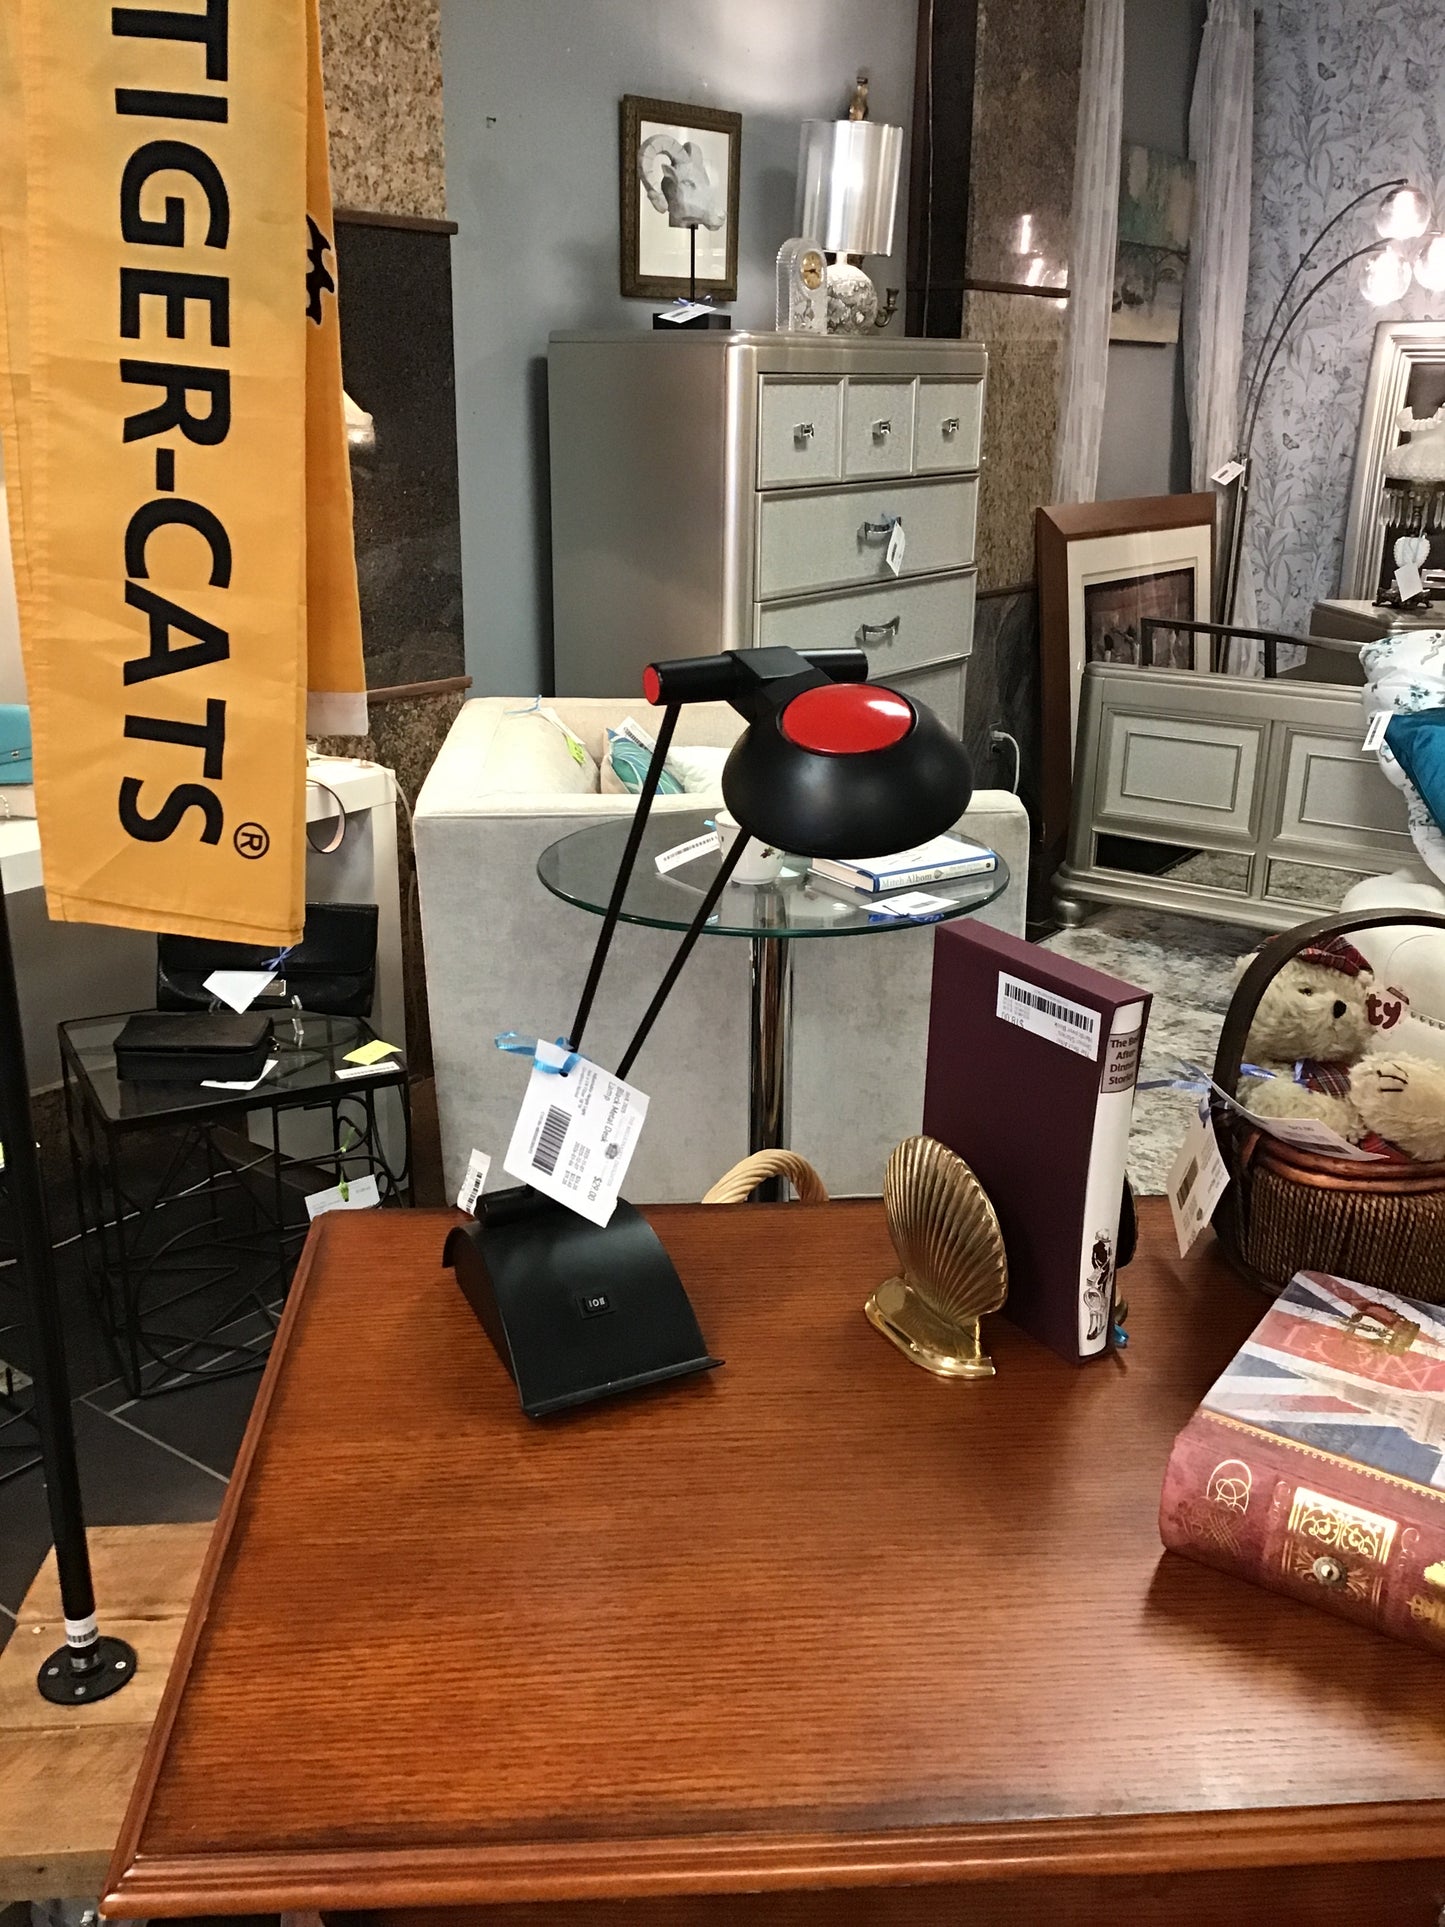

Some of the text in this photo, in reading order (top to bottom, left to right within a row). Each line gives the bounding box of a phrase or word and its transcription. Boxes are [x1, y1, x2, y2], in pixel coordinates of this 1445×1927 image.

[907, 874, 932, 884] Albom
[1364, 993, 1402, 1030] ty
[1110, 1039, 1127, 1048] The
[1116, 1049, 1136, 1060] After
[1110, 1060, 1135, 1072] Dinner
[603, 1081, 616, 1101] Lamp
[600, 1086, 625, 1142] Black Metal Desk
[588, 1175, 603, 1201] $29.00
